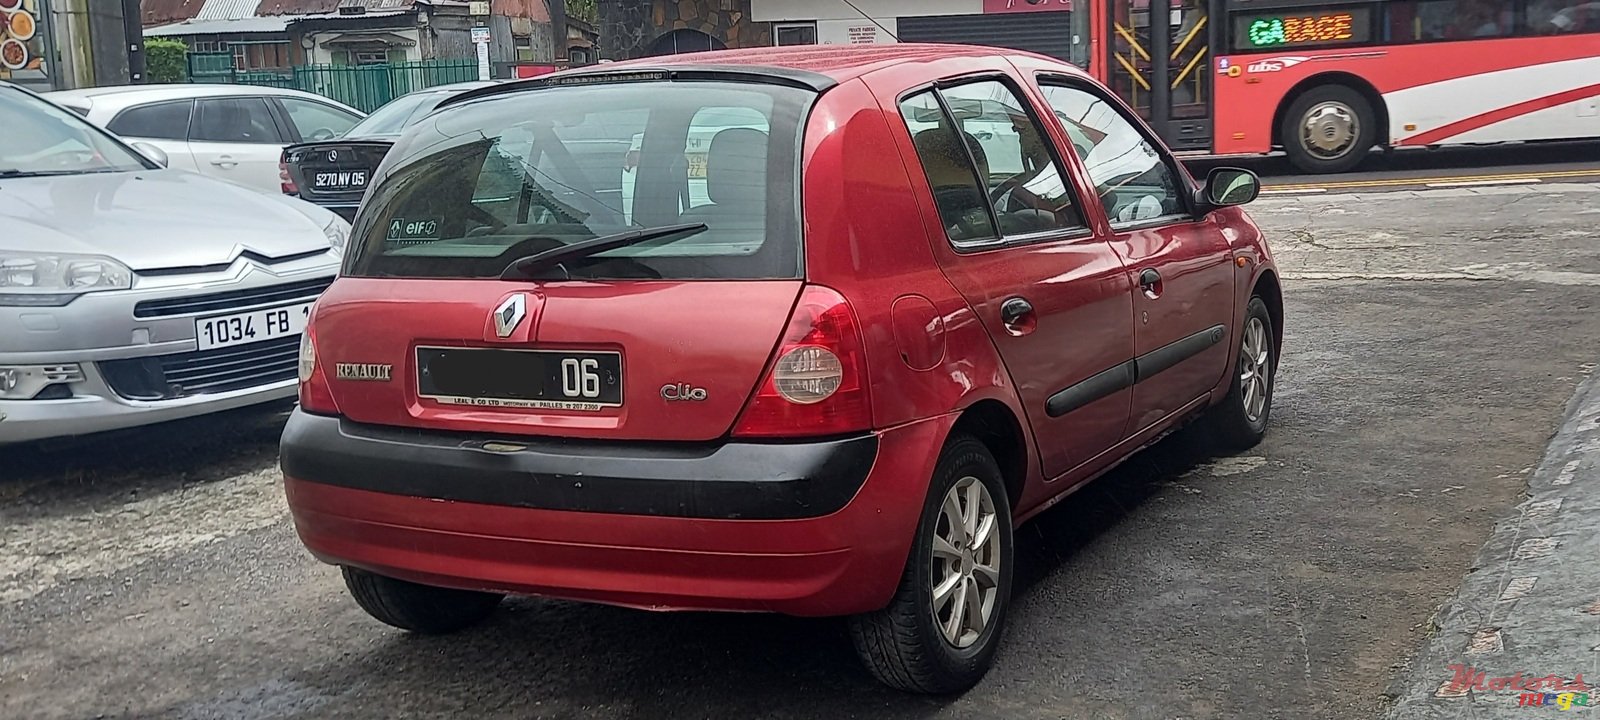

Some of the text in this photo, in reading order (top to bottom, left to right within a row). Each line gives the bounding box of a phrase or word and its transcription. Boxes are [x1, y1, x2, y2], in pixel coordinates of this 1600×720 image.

[1248, 14, 1353, 45] GARAGE
[1247, 61, 1283, 73] ubs
[315, 172, 365, 187] 5270 NV 05
[406, 221, 426, 235] elf
[204, 315, 256, 345] 1034
[265, 309, 290, 336] FB
[335, 362, 393, 380] RENAULT
[561, 358, 600, 398] 06
[660, 382, 707, 401] Clio
